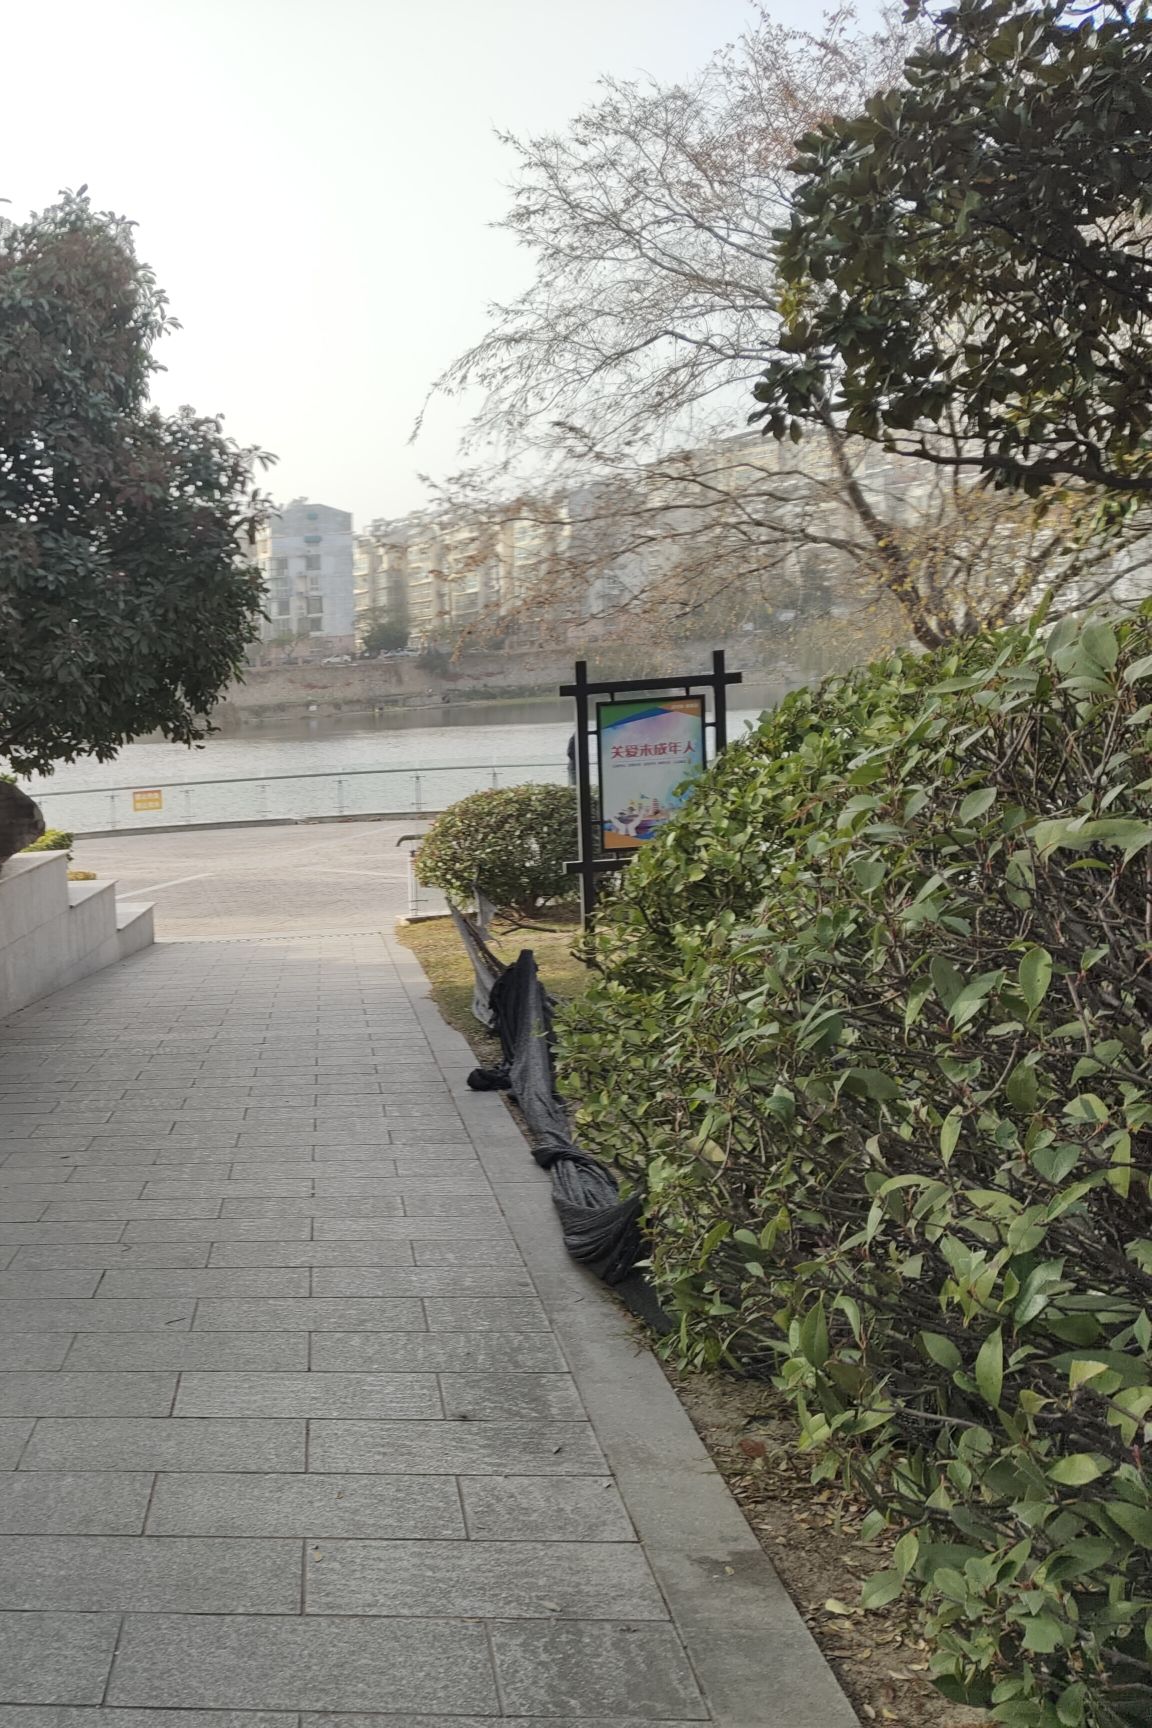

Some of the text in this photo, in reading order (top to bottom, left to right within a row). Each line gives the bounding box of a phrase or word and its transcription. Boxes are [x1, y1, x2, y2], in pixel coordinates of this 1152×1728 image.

[611, 741, 695, 758] 关爱未成年人
